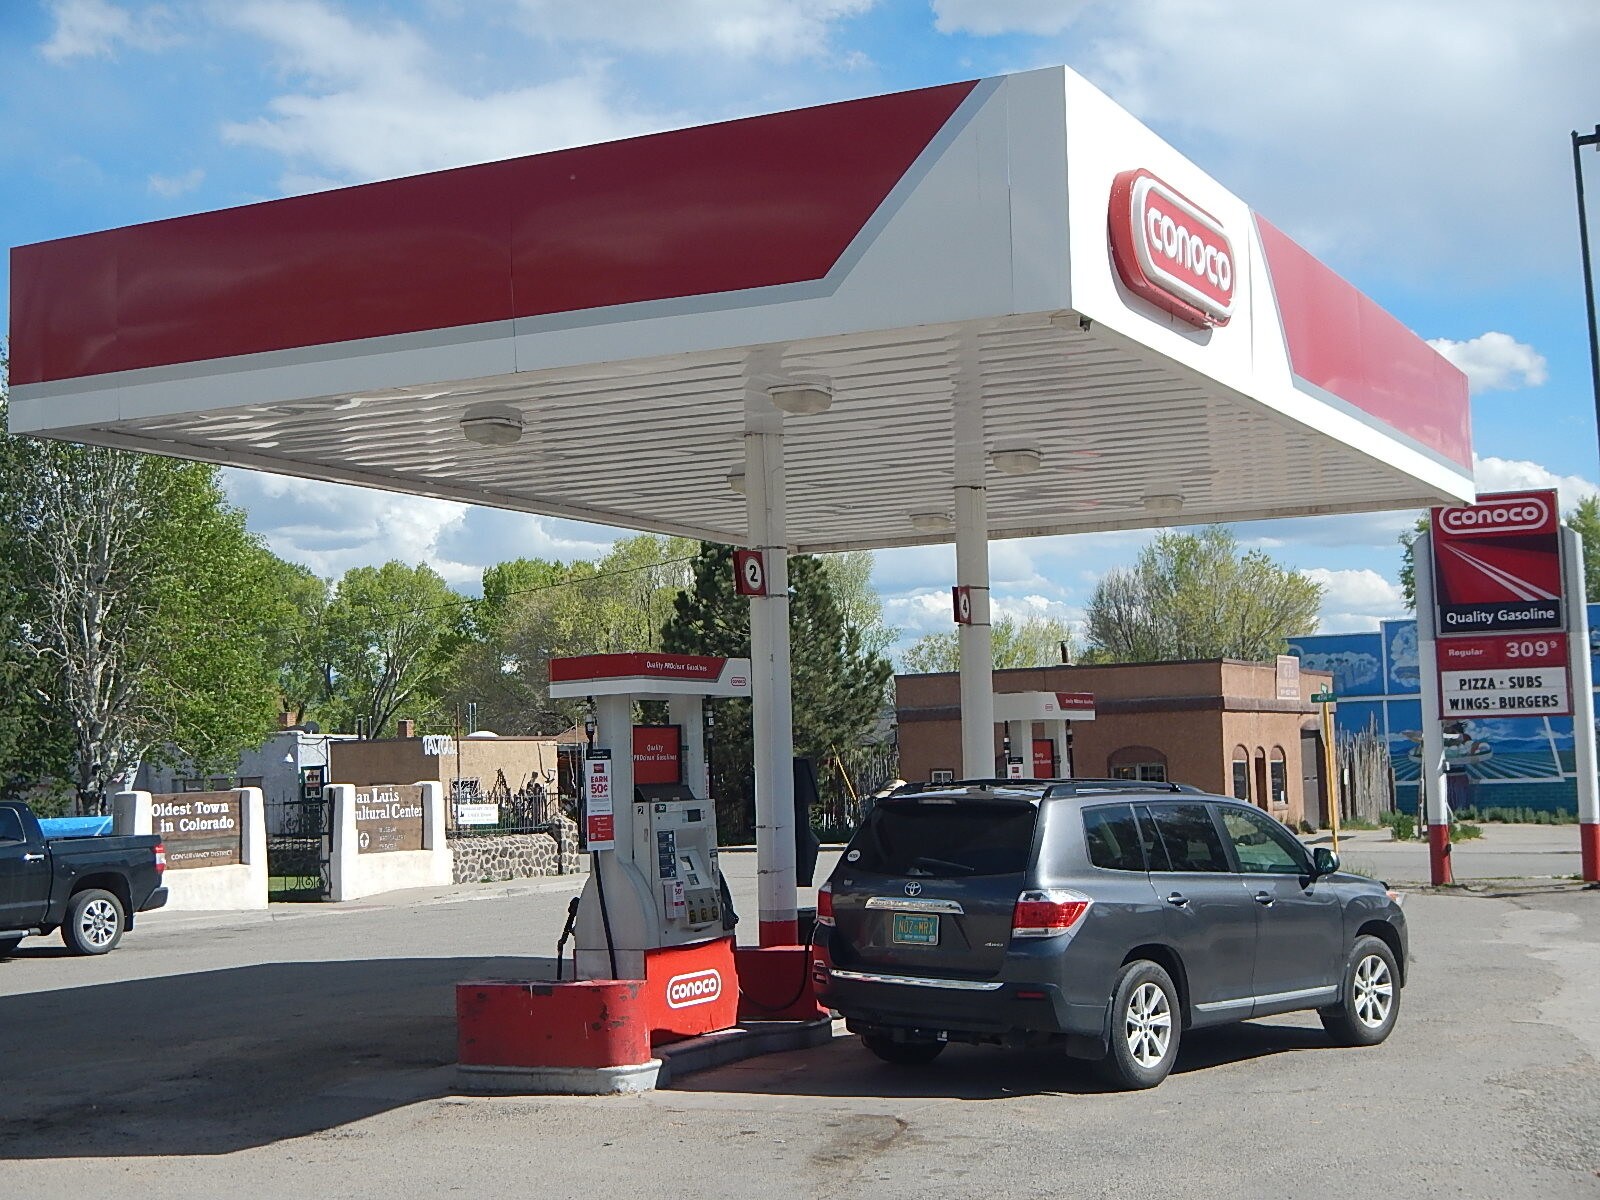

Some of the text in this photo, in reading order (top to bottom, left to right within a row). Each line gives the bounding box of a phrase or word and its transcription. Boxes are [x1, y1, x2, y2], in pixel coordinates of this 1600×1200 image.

[749, 564, 758, 582] 2
[1446, 607, 1556, 625] Quality Gasoline
[1448, 648, 1484, 658] Regular
[646, 661, 663, 670] Quality
[686, 663, 707, 671] Gasolines
[1459, 676, 1543, 690] PIZZA SUBS
[1449, 694, 1559, 710] WINGS BURGERS
[646, 744, 664, 752] Quality
[590, 775, 608, 783] EARN
[356, 787, 400, 804] an Luis
[152, 801, 229, 816] Oldest Town
[355, 804, 390, 820] ultural
[160, 816, 235, 833] in Colorado
[210, 849, 233, 857] DISTRICT
